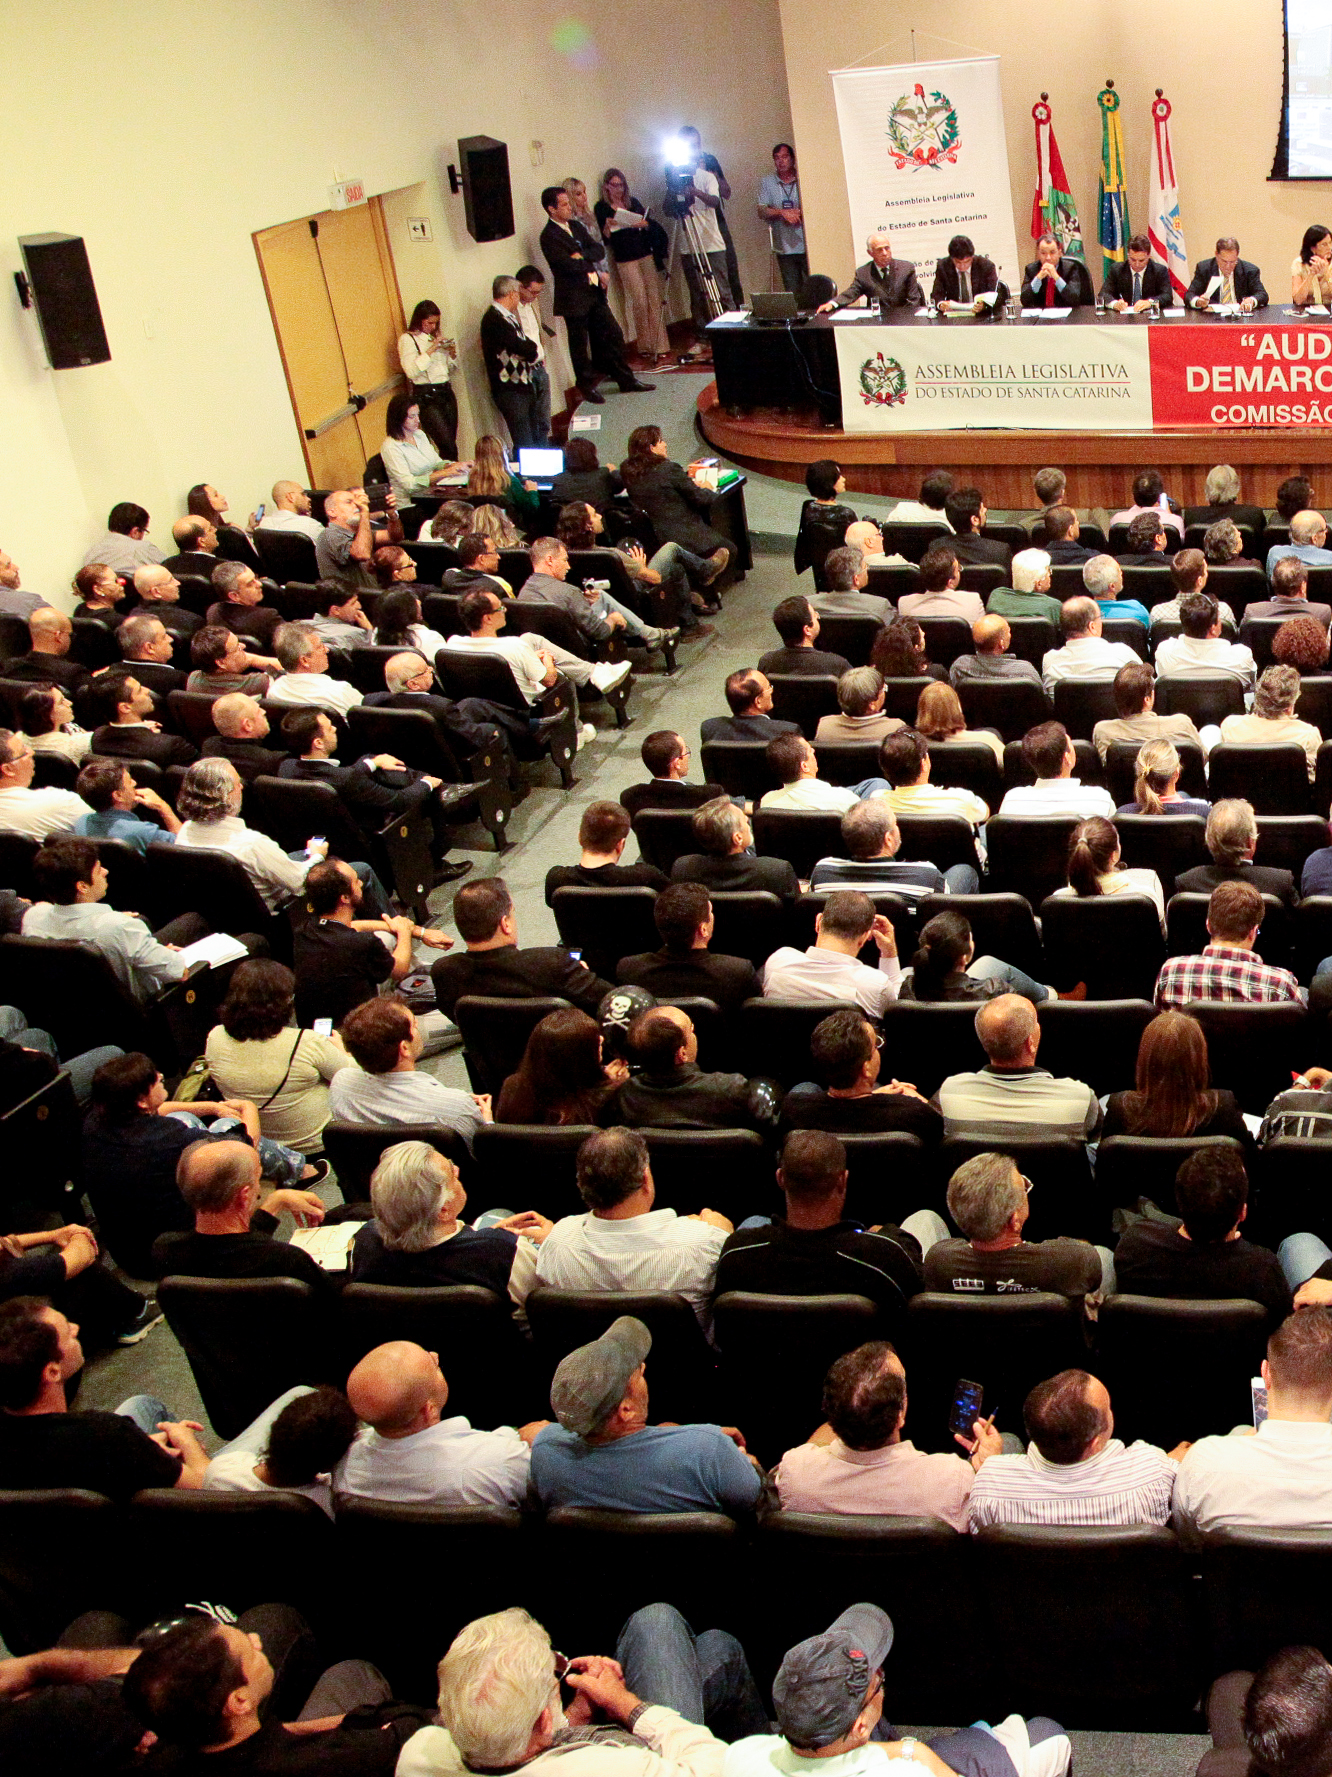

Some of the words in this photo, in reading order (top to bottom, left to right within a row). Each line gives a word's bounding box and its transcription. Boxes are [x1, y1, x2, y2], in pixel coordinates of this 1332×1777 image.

[885, 196, 930, 207] Assembleia
[932, 191, 975, 203] Legislativa
[889, 222, 916, 230] Estado
[918, 219, 928, 227] de
[930, 217, 953, 226] Santa
[954, 213, 988, 222] Catarina
[914, 364, 1016, 379] ASSEMBLEIA
[1022, 363, 1129, 379] LEGISLATIVA
[915, 387, 937, 399] DO
[941, 387, 992, 399] ESTADO
[996, 386, 1014, 399] DE
[1017, 387, 1060, 399] SANTA
[1063, 387, 1131, 399] CATARINA
